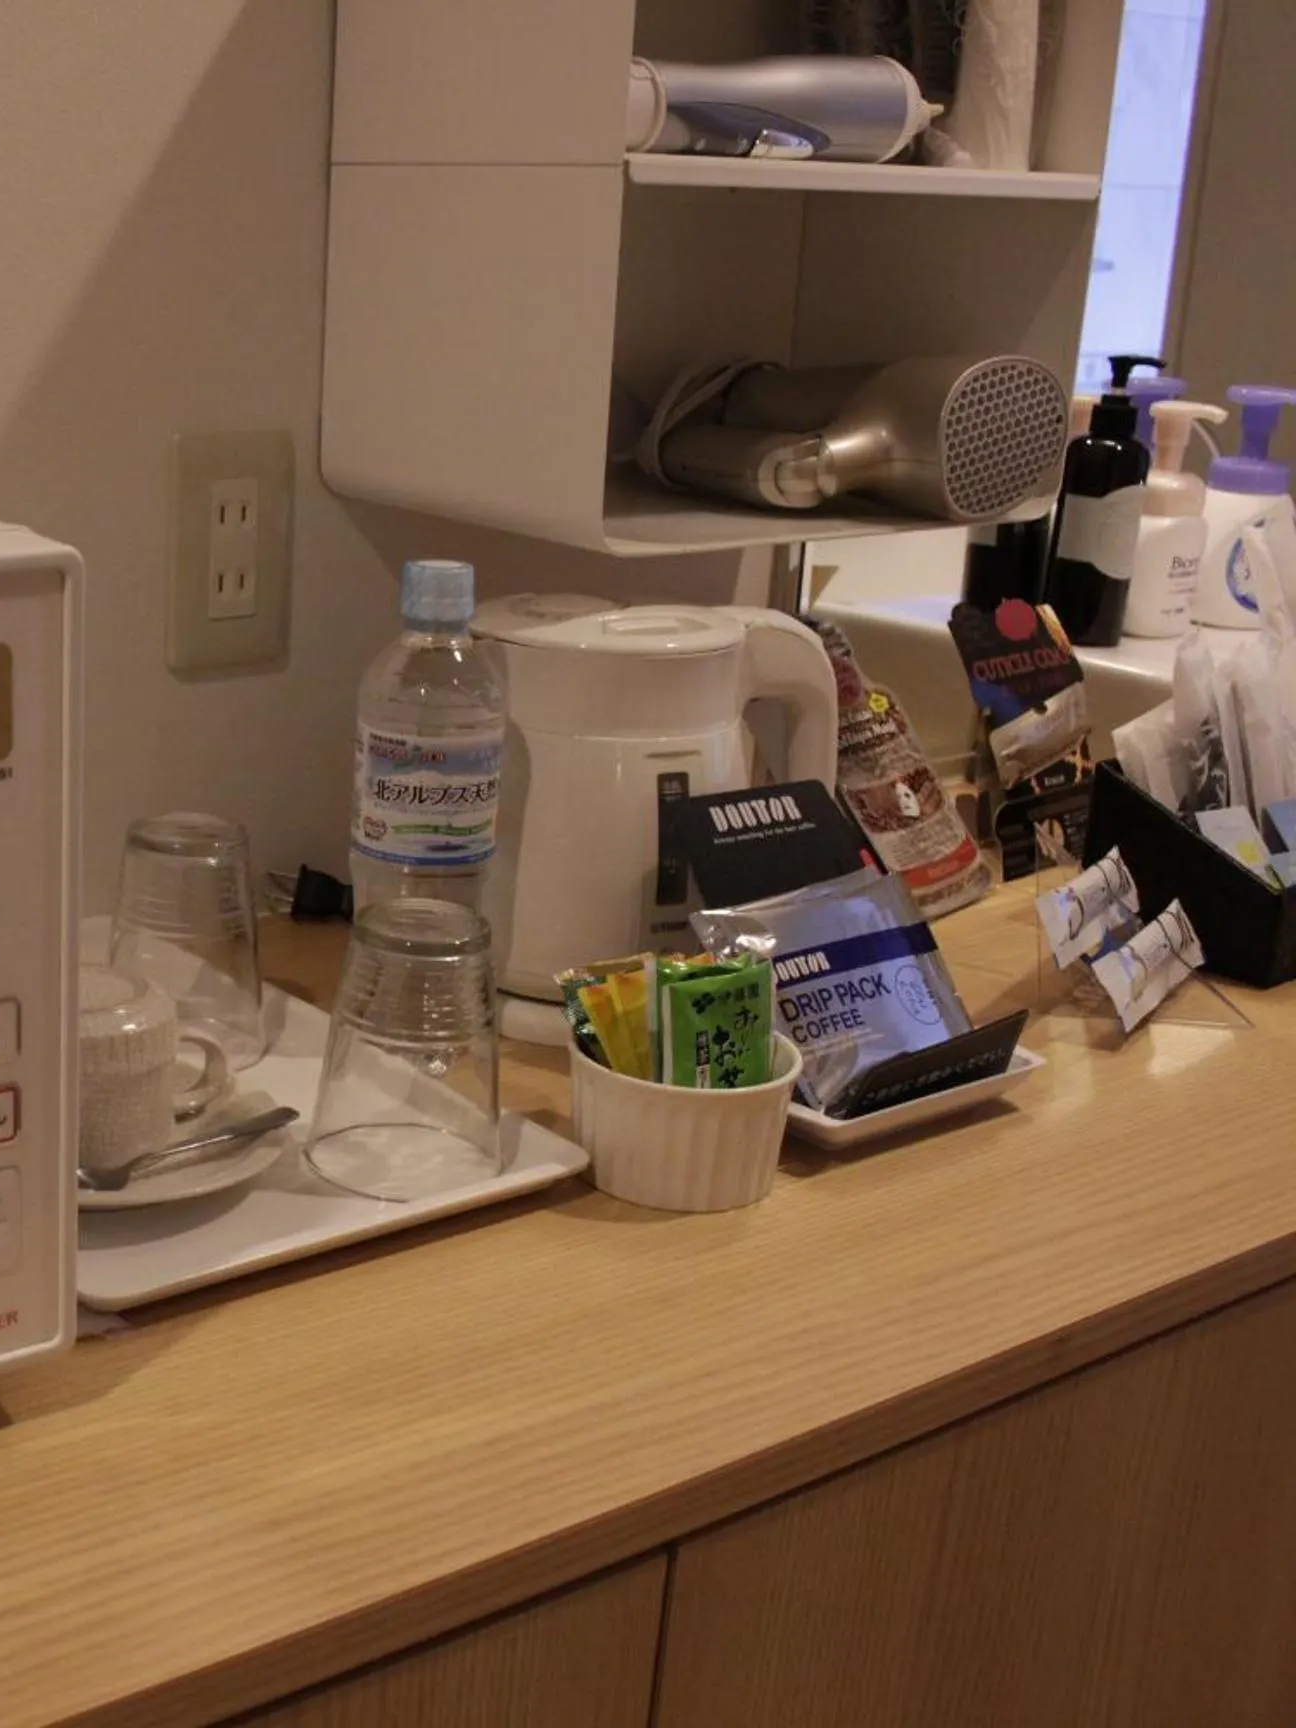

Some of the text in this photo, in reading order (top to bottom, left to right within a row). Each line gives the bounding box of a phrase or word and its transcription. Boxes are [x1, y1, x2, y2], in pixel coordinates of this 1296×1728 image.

[708, 795, 802, 832] DOUTOR
[775, 951, 831, 982] OUTOR
[778, 987, 832, 1022] DRIP
[834, 973, 892, 1006] PACK
[791, 1008, 866, 1044] COFFEE
